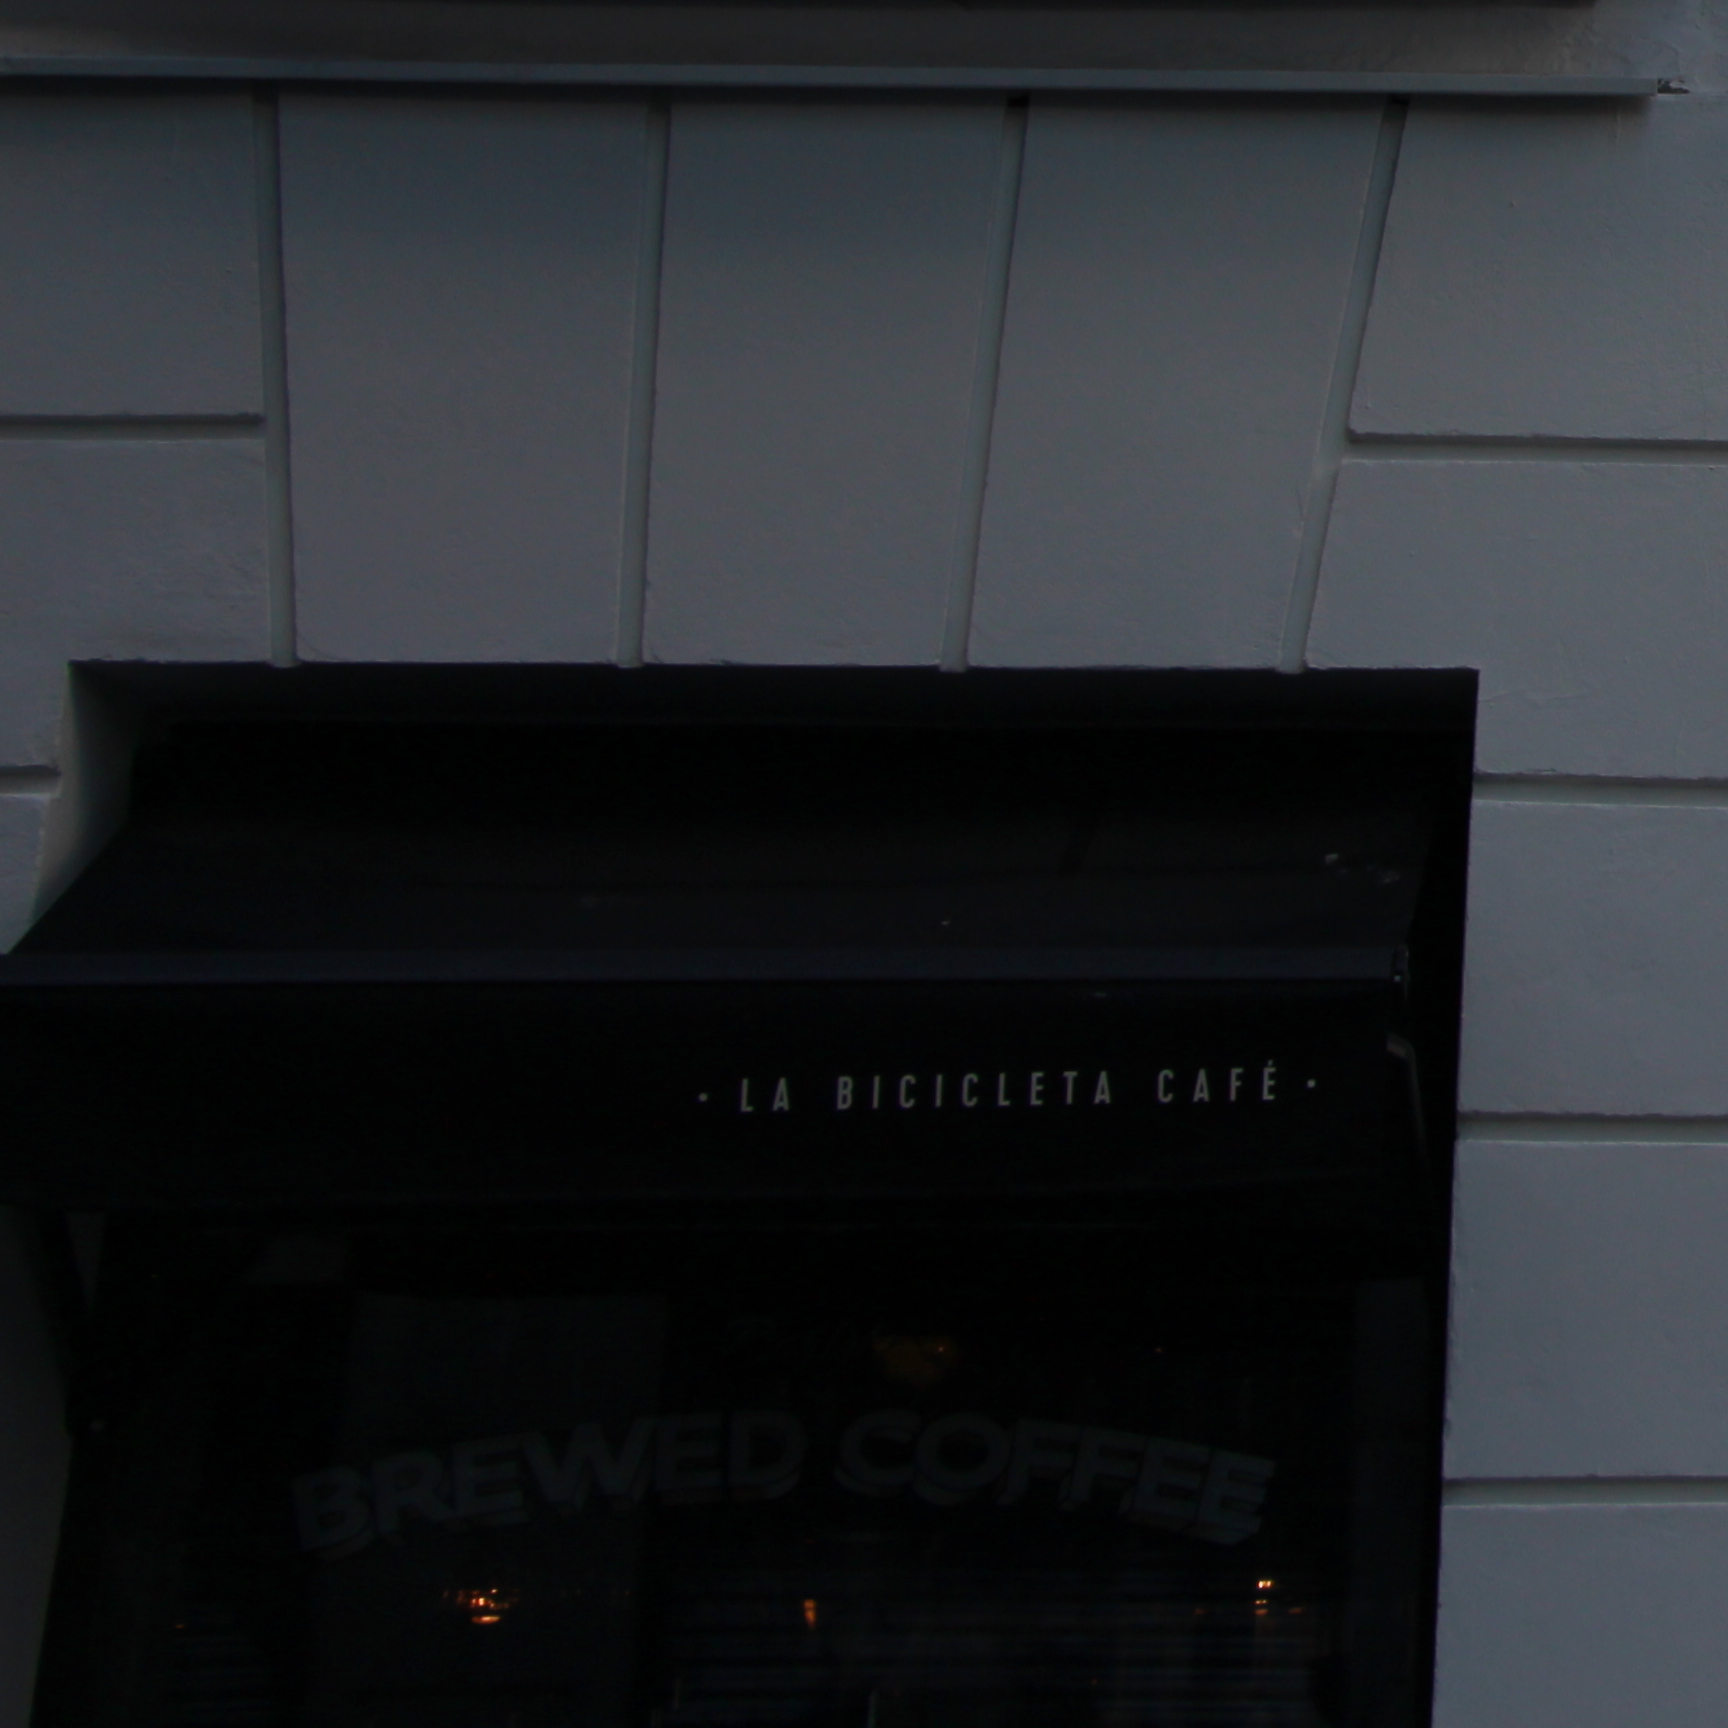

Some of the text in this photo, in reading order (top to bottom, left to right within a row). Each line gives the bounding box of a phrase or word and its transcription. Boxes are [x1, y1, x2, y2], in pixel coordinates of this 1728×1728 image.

[738, 1059, 1278, 1113] LA BICICLETA CAFÉ
[289, 1410, 1277, 1560] BREWED COFFEE
